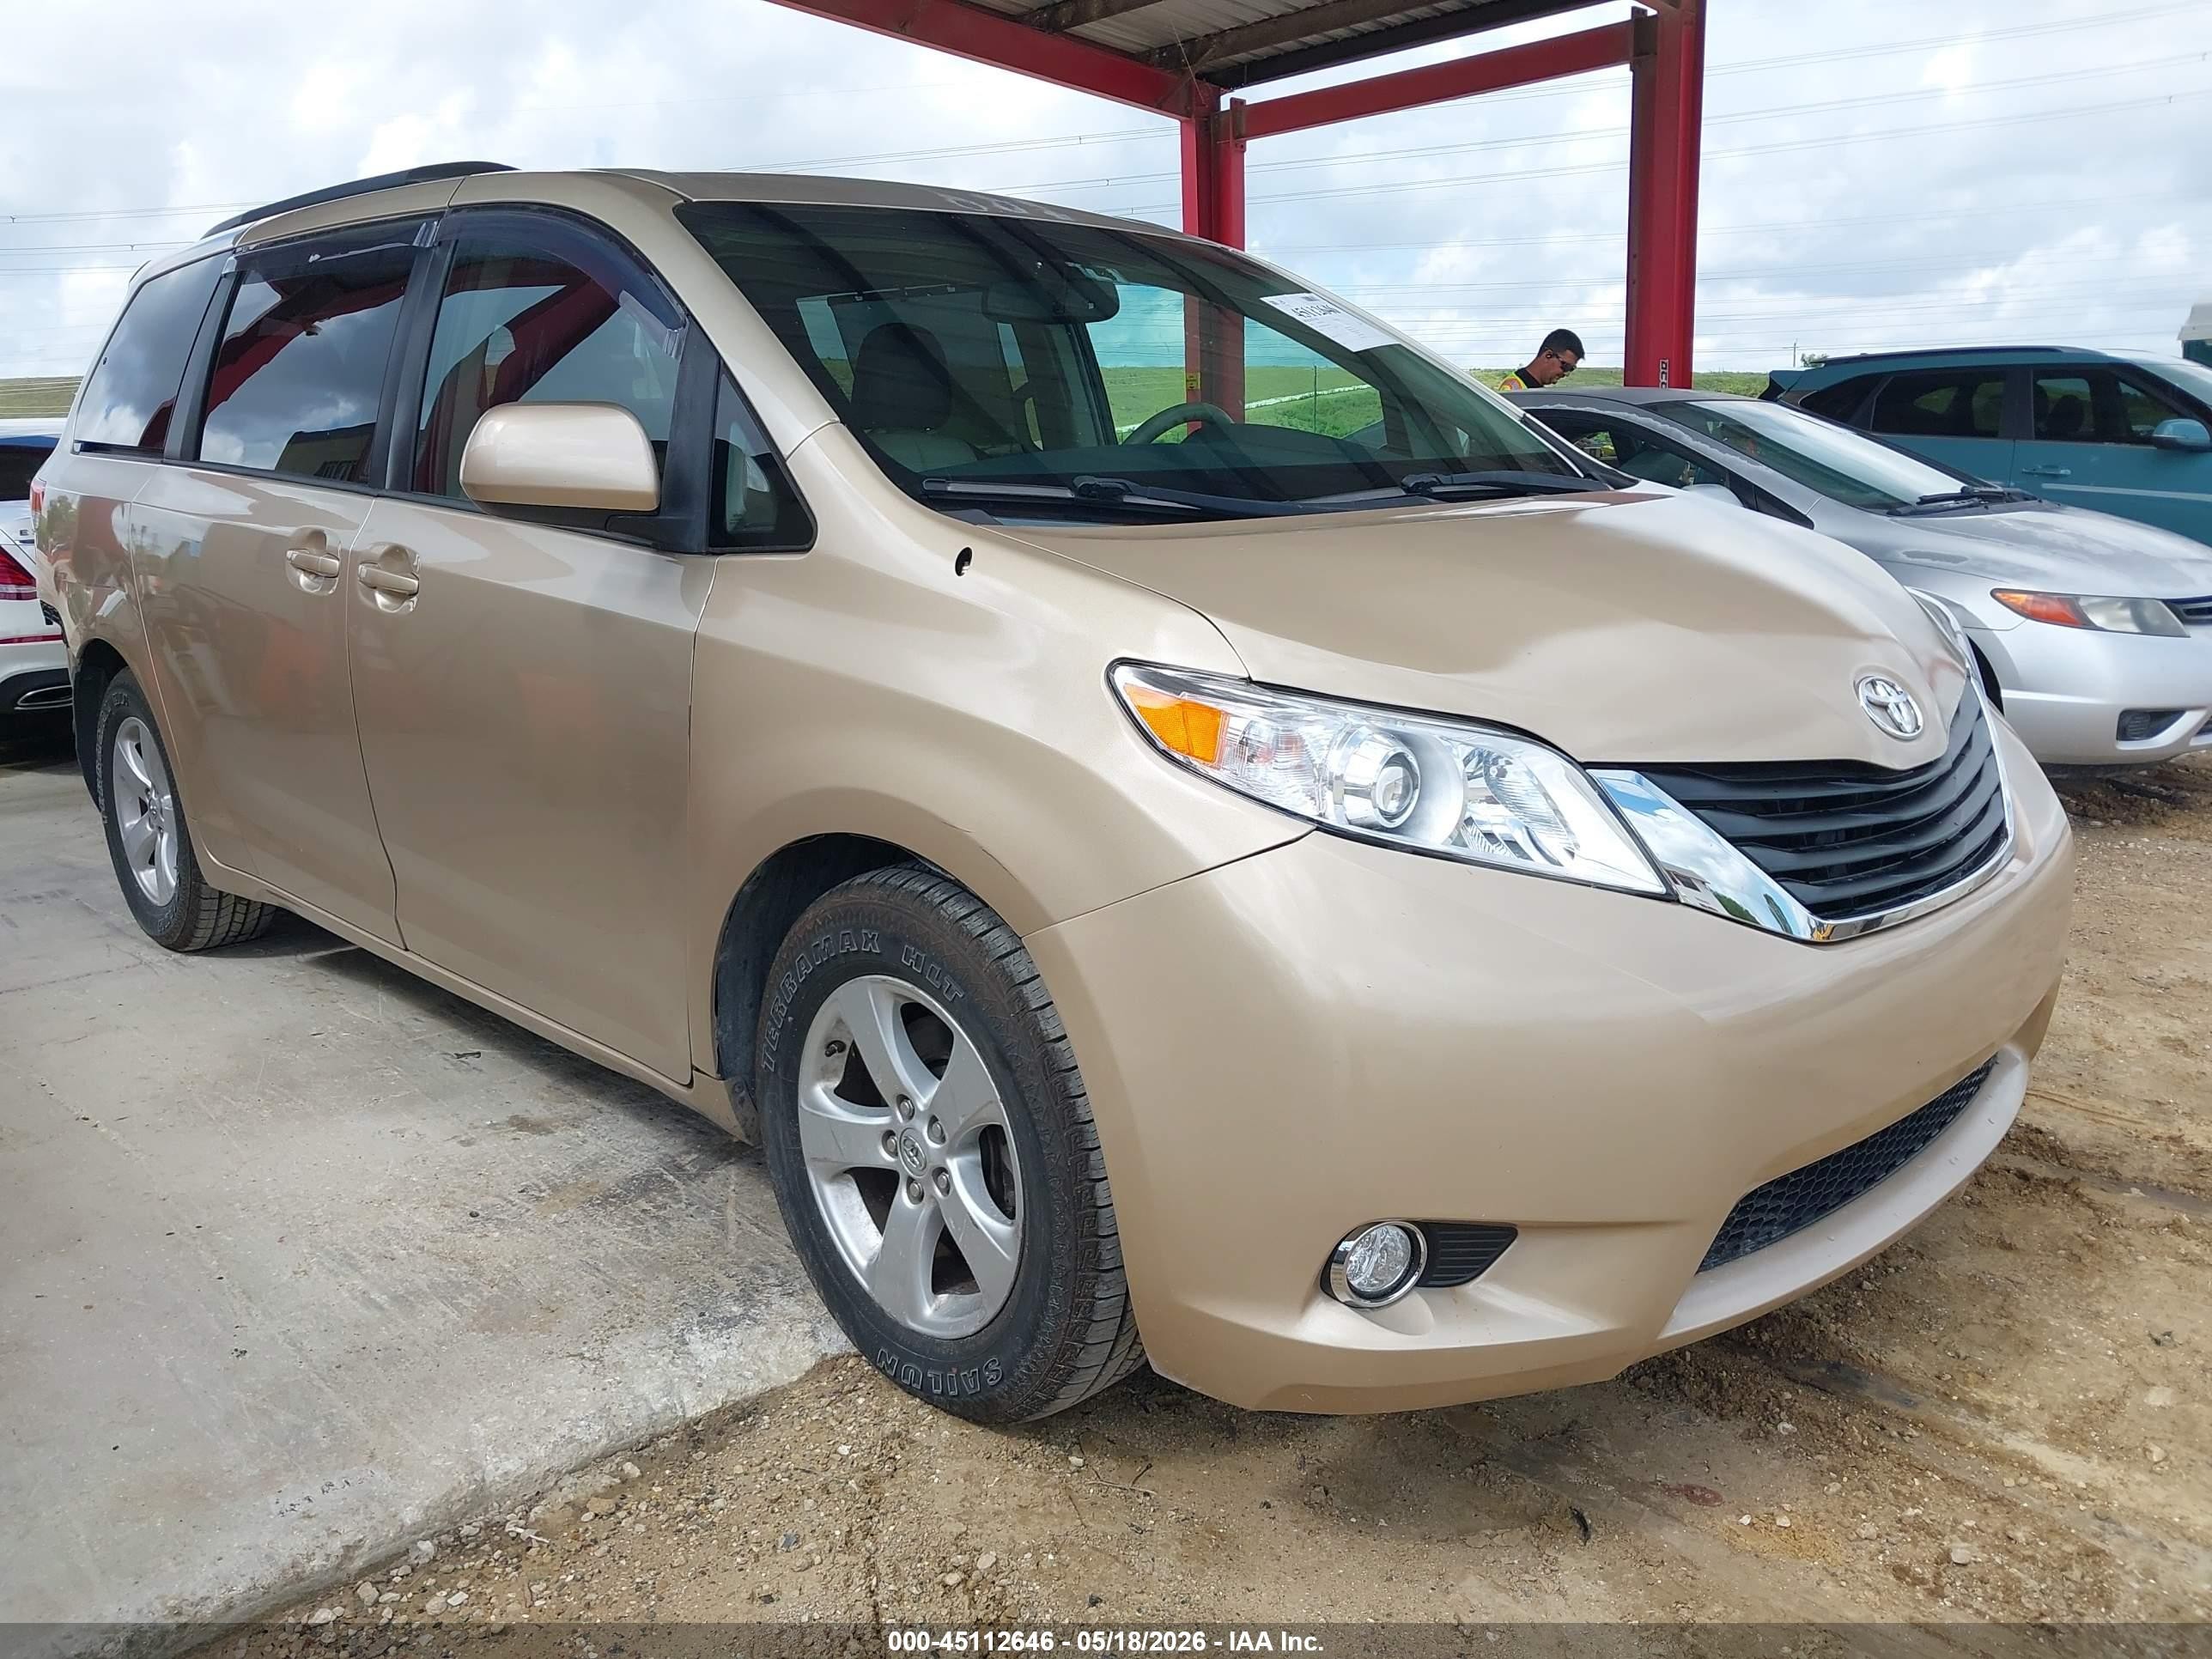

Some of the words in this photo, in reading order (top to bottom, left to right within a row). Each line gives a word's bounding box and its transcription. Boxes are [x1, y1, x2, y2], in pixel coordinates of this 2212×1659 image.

[761, 929, 881, 1073] TERRAMAX
[902, 945, 964, 1002] HLT
[876, 1346, 1003, 1395] SAILUN
